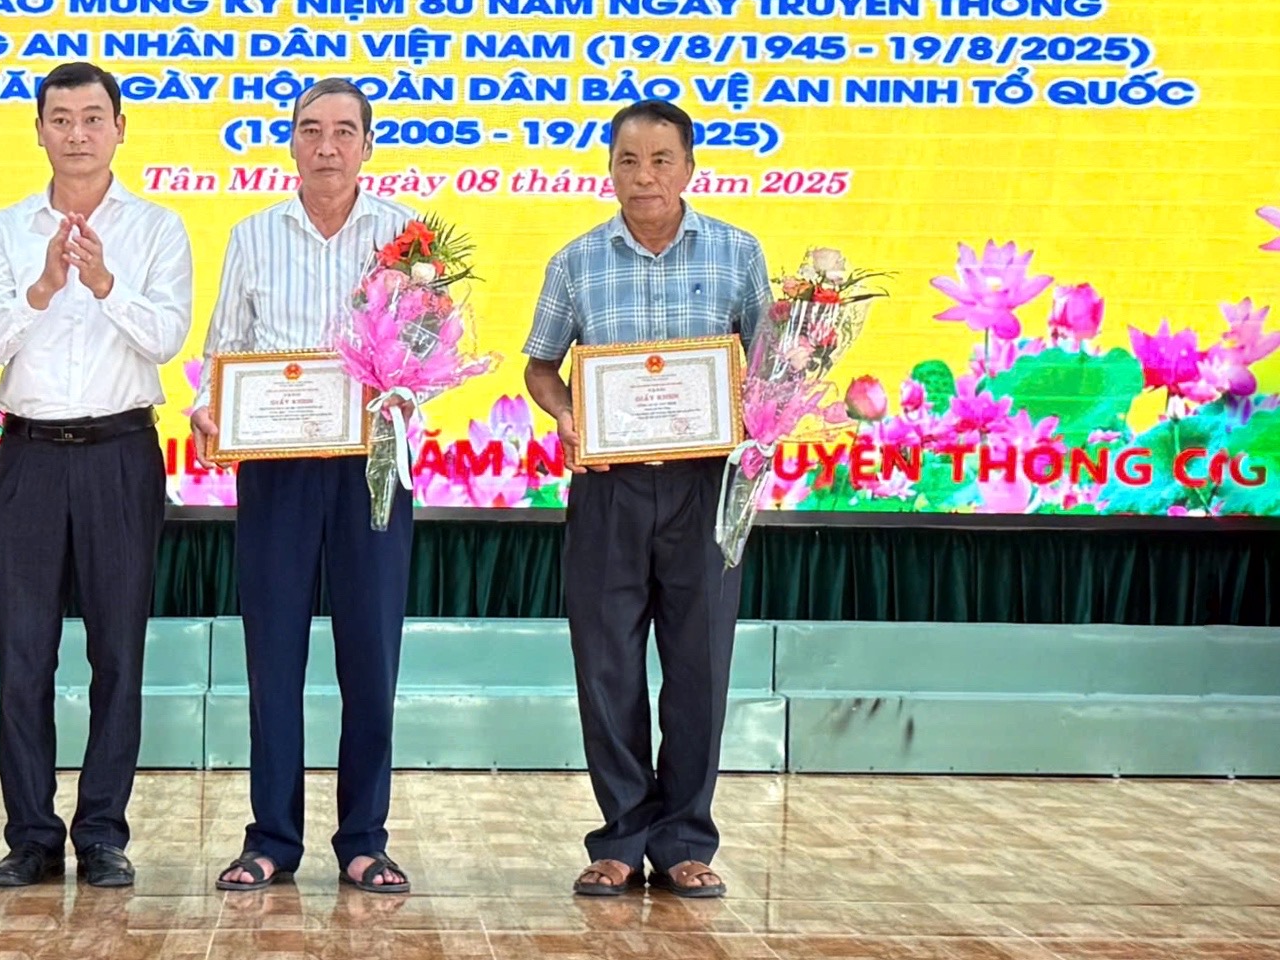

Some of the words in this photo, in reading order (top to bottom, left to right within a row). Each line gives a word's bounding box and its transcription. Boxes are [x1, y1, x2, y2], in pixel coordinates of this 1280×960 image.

[23, 34, 87, 57] AN
[105, 27, 233, 57] NHÂN
[251, 28, 346, 57] DÂN
[363, 28, 451, 64] VIỆT
[466, 35, 569, 58] NAM
[587, 35, 845, 65] (19/8/1945
[890, 37, 1150, 70] 19/8/2025)
[119, 70, 218, 100] GÀY
[342, 71, 453, 101] OÀN
[470, 72, 566, 101] DÂN
[583, 70, 680, 102] BẢO
[695, 72, 749, 109] VỆ
[764, 80, 828, 102] AN
[846, 80, 957, 103] NINH
[973, 66, 1033, 105] TỔ
[1048, 66, 1194, 106] QUỐC
[145, 167, 216, 191] Tân
[457, 170, 499, 192] 08
[684, 171, 748, 193] ăm
[760, 171, 849, 194] 2025
[939, 434, 1154, 486] THỐNG
